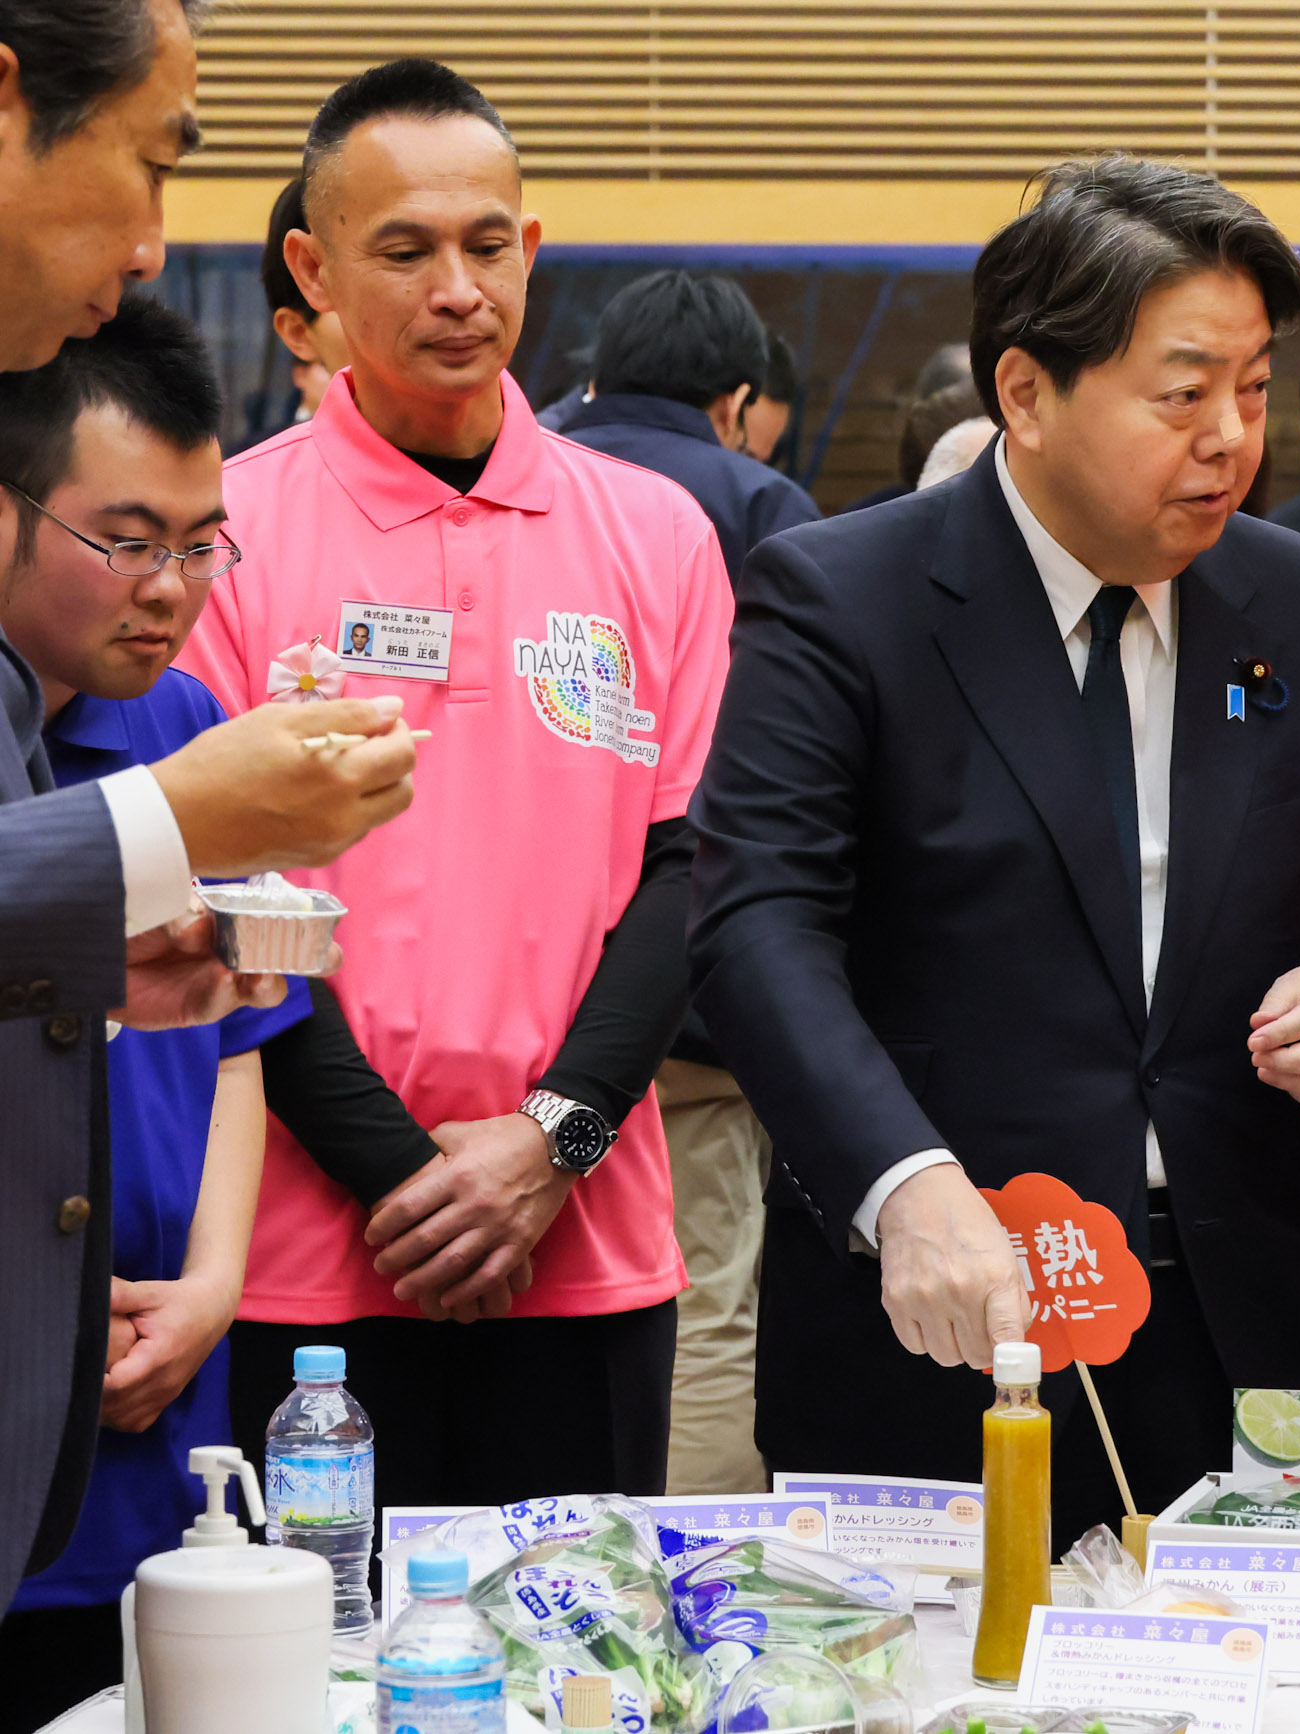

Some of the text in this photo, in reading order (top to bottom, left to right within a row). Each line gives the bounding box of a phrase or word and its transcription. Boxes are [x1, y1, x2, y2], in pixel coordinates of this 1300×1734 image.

[363, 610, 431, 625] 株式会社 菜々屋
[381, 625, 447, 638] 株式会社カネイファーム
[552, 616, 587, 646] NA
[386, 645, 439, 660] 新田 正信
[625, 712, 651, 727] noen
[876, 1492, 934, 1509] 菜々屋
[714, 1511, 775, 1527] 菜々屋
[1161, 1556, 1231, 1569] 株式会社
[1051, 1622, 1209, 1642] 株式会社 菜々屋
